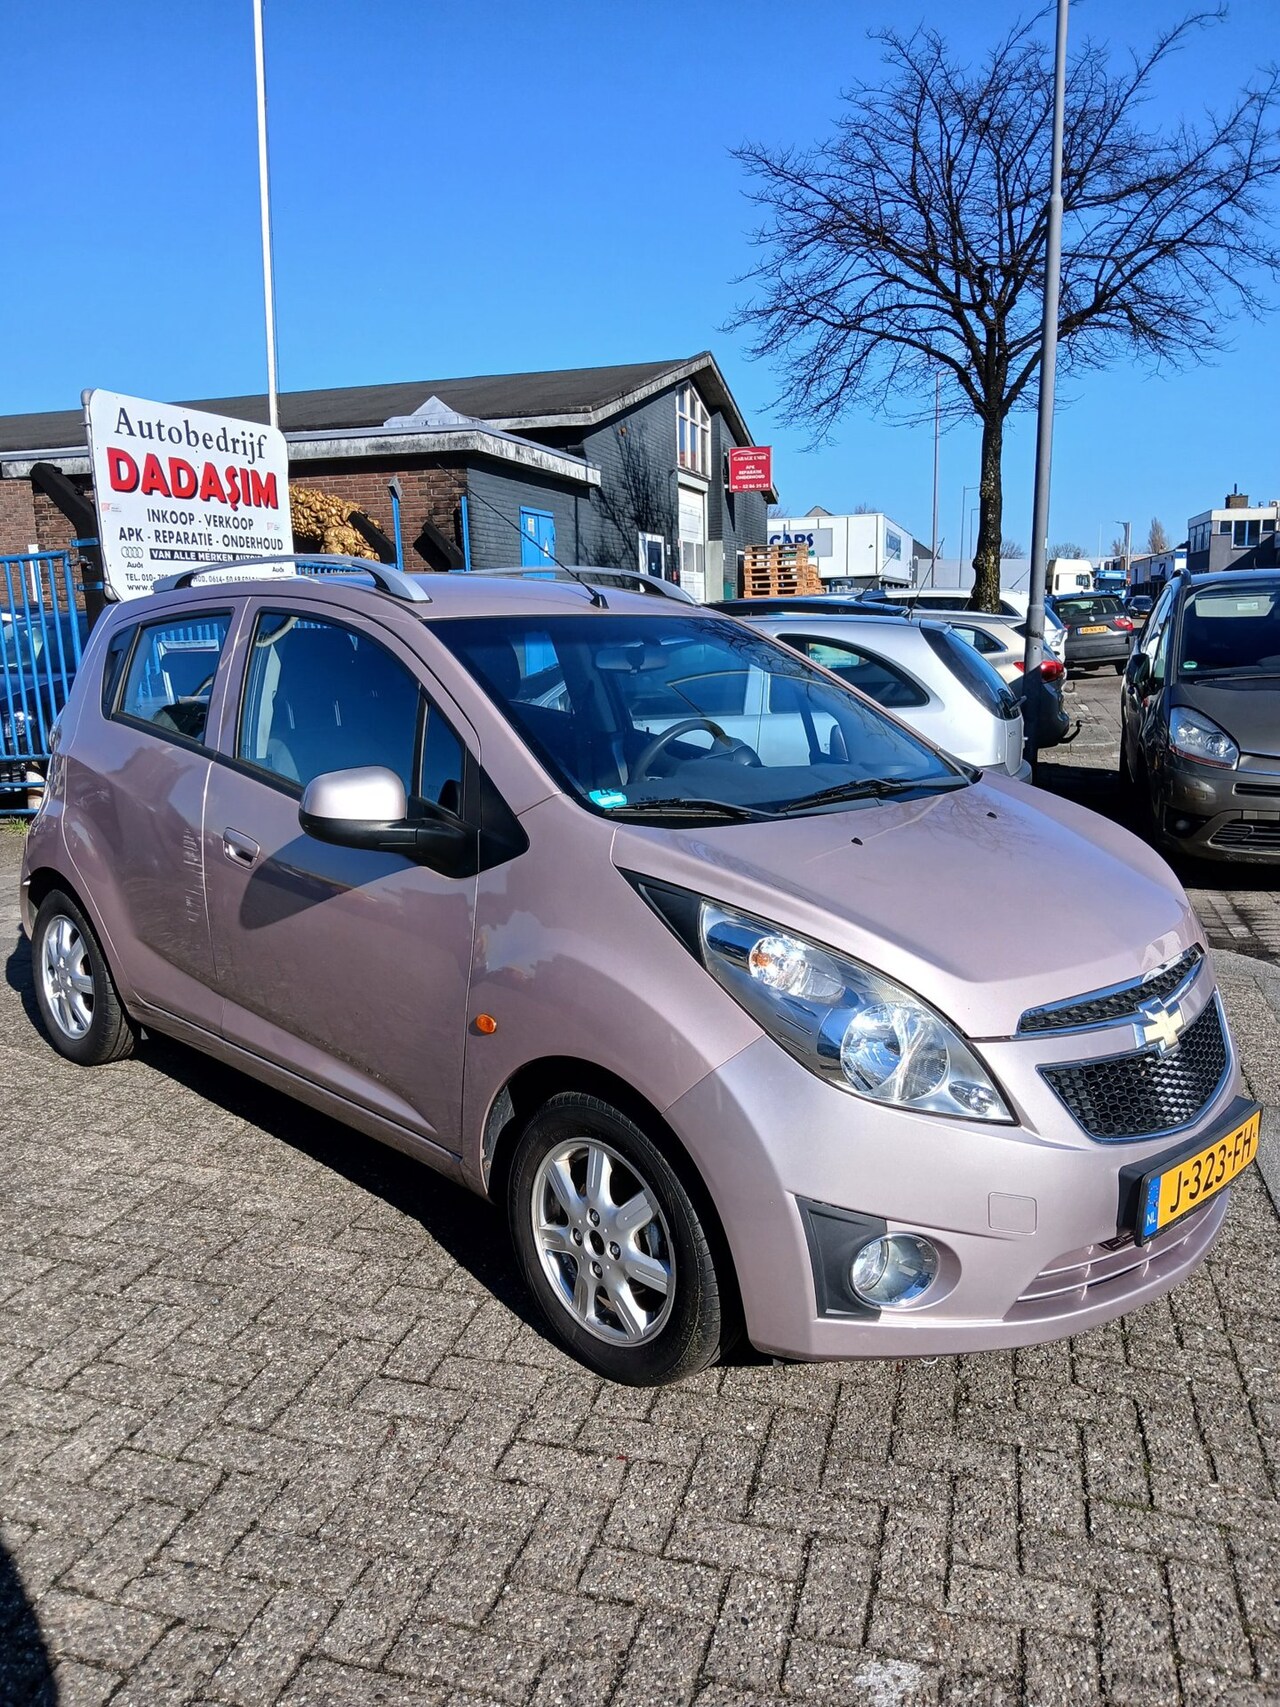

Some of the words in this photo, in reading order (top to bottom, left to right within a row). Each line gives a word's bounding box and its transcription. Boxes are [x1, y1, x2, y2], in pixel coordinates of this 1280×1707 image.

[114, 407, 268, 465] Autobedrijf
[106, 446, 279, 512] DADAŞIM
[147, 508, 195, 526] INKOOP
[204, 513, 254, 531] VERKOOP
[118, 527, 145, 543] APK
[154, 529, 213, 547] REPARATIE
[221, 534, 284, 551] ONDERHOUD
[151, 549, 172, 559] VAN
[173, 551, 196, 560] ALLE
[197, 552, 233, 562] MERKEN
[125, 573, 141, 581] TEL.
[1170, 1123, 1254, 1213] J-323-FH
[1146, 1214, 1156, 1226] NL
